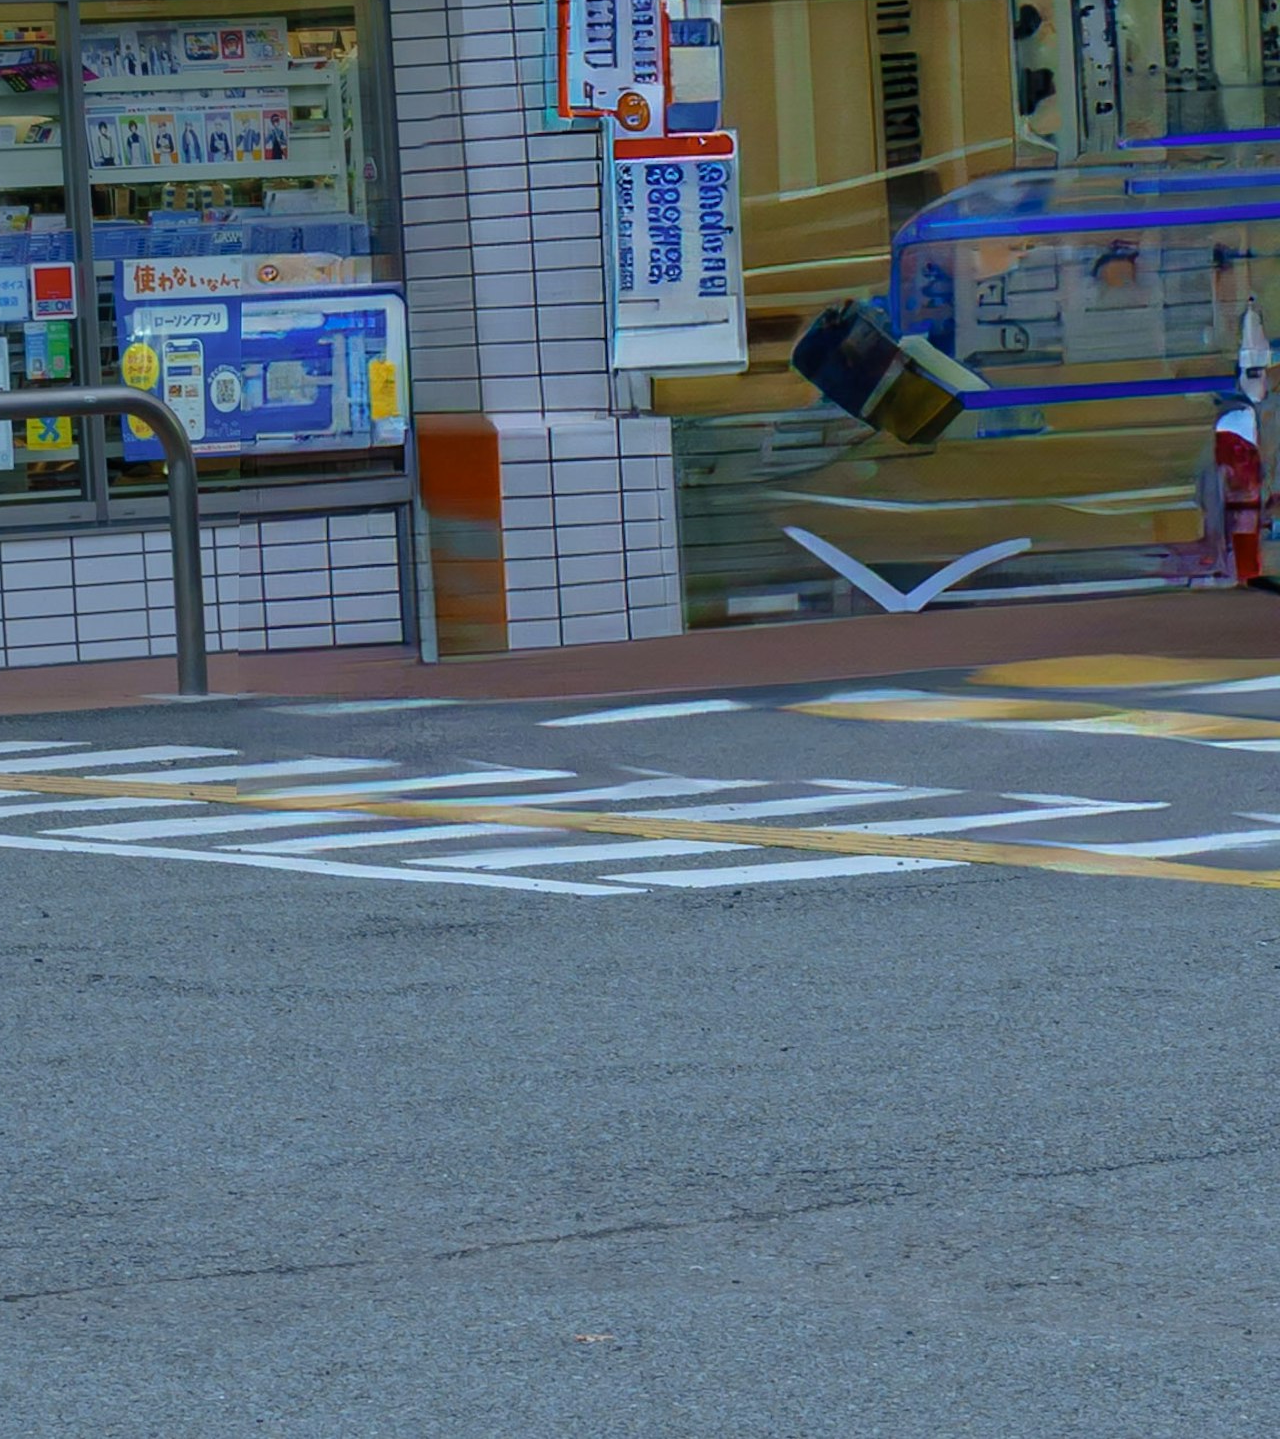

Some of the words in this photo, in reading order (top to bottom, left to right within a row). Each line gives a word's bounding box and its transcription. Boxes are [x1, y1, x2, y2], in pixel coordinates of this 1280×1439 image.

[153, 311, 221, 329] ローソンアプリ
